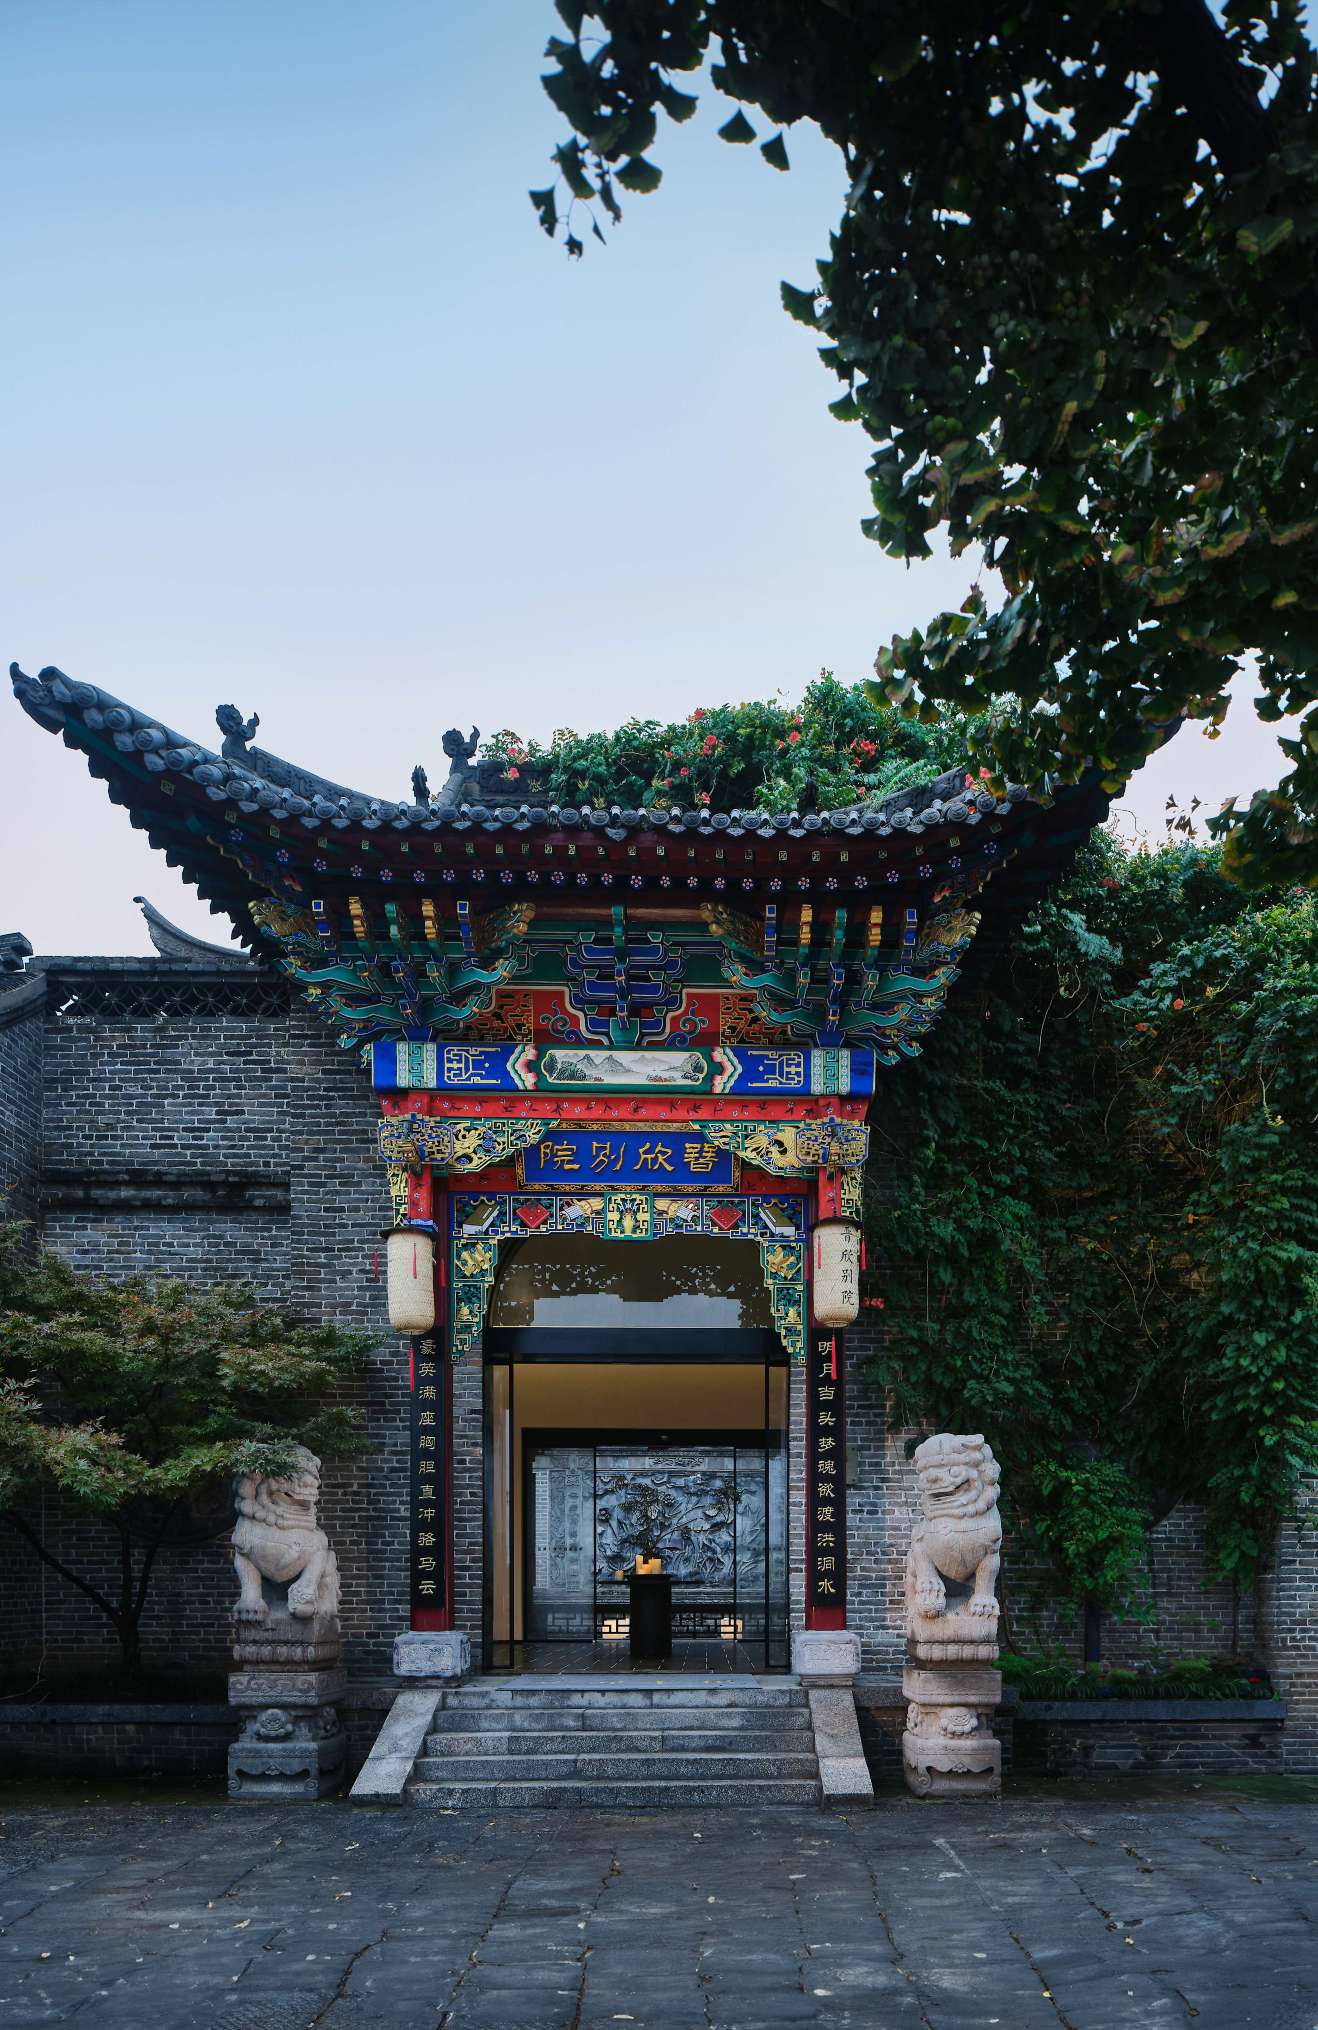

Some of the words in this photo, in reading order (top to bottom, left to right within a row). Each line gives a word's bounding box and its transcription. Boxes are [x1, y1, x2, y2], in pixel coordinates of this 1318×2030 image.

[817, 1341, 837, 1595] 明月当头梦魂欲渡洪洞水
